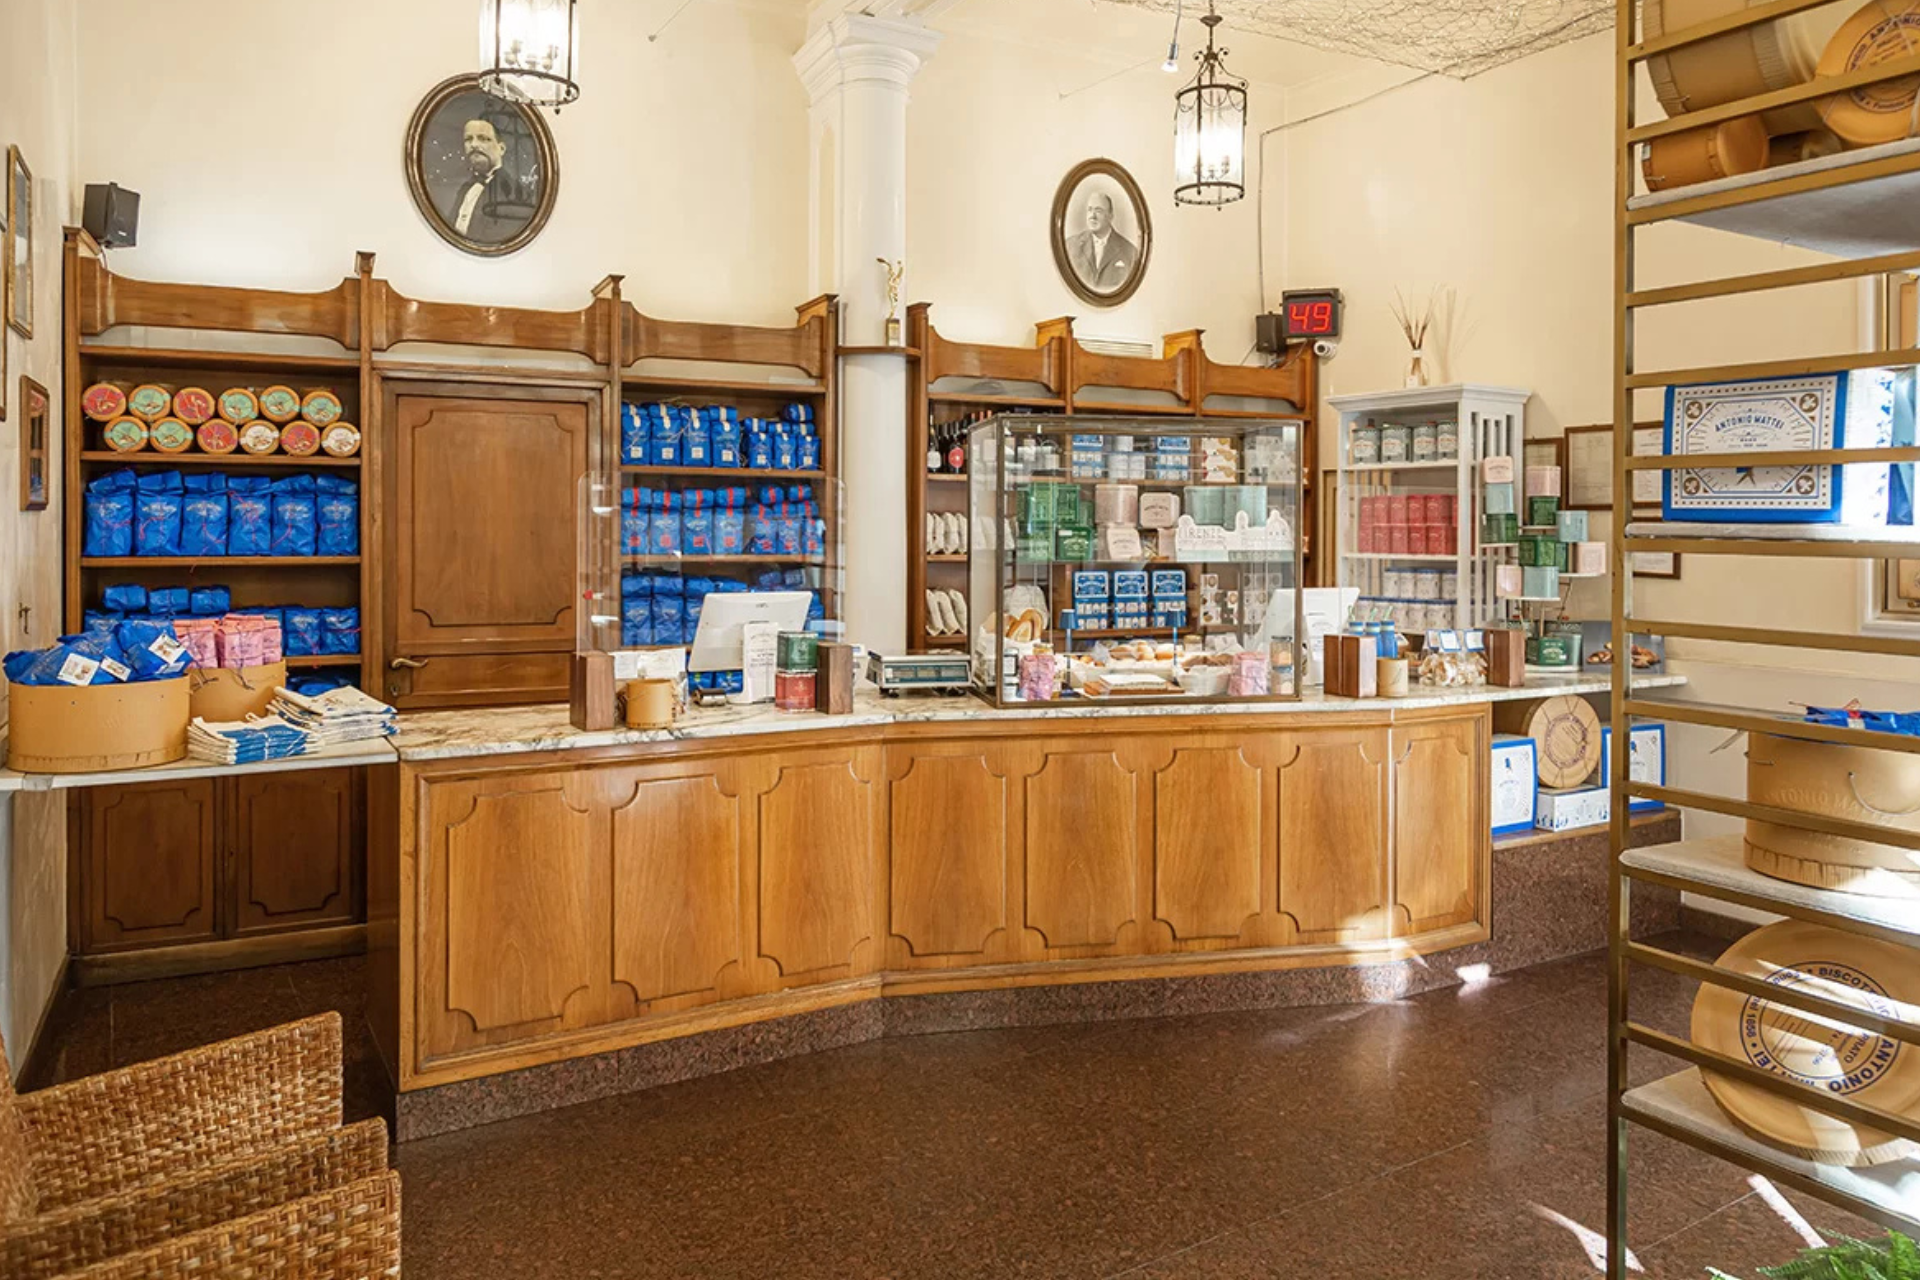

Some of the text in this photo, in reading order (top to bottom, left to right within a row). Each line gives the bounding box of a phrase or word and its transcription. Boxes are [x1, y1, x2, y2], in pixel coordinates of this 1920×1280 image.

[1291, 302, 1331, 332] 49
[1715, 414, 1752, 432] ANTONIO
[1754, 414, 1785, 430] MATTEI
[1844, 1032, 1870, 1064] PRATO
[1829, 1038, 1895, 1093] ANTONIO
